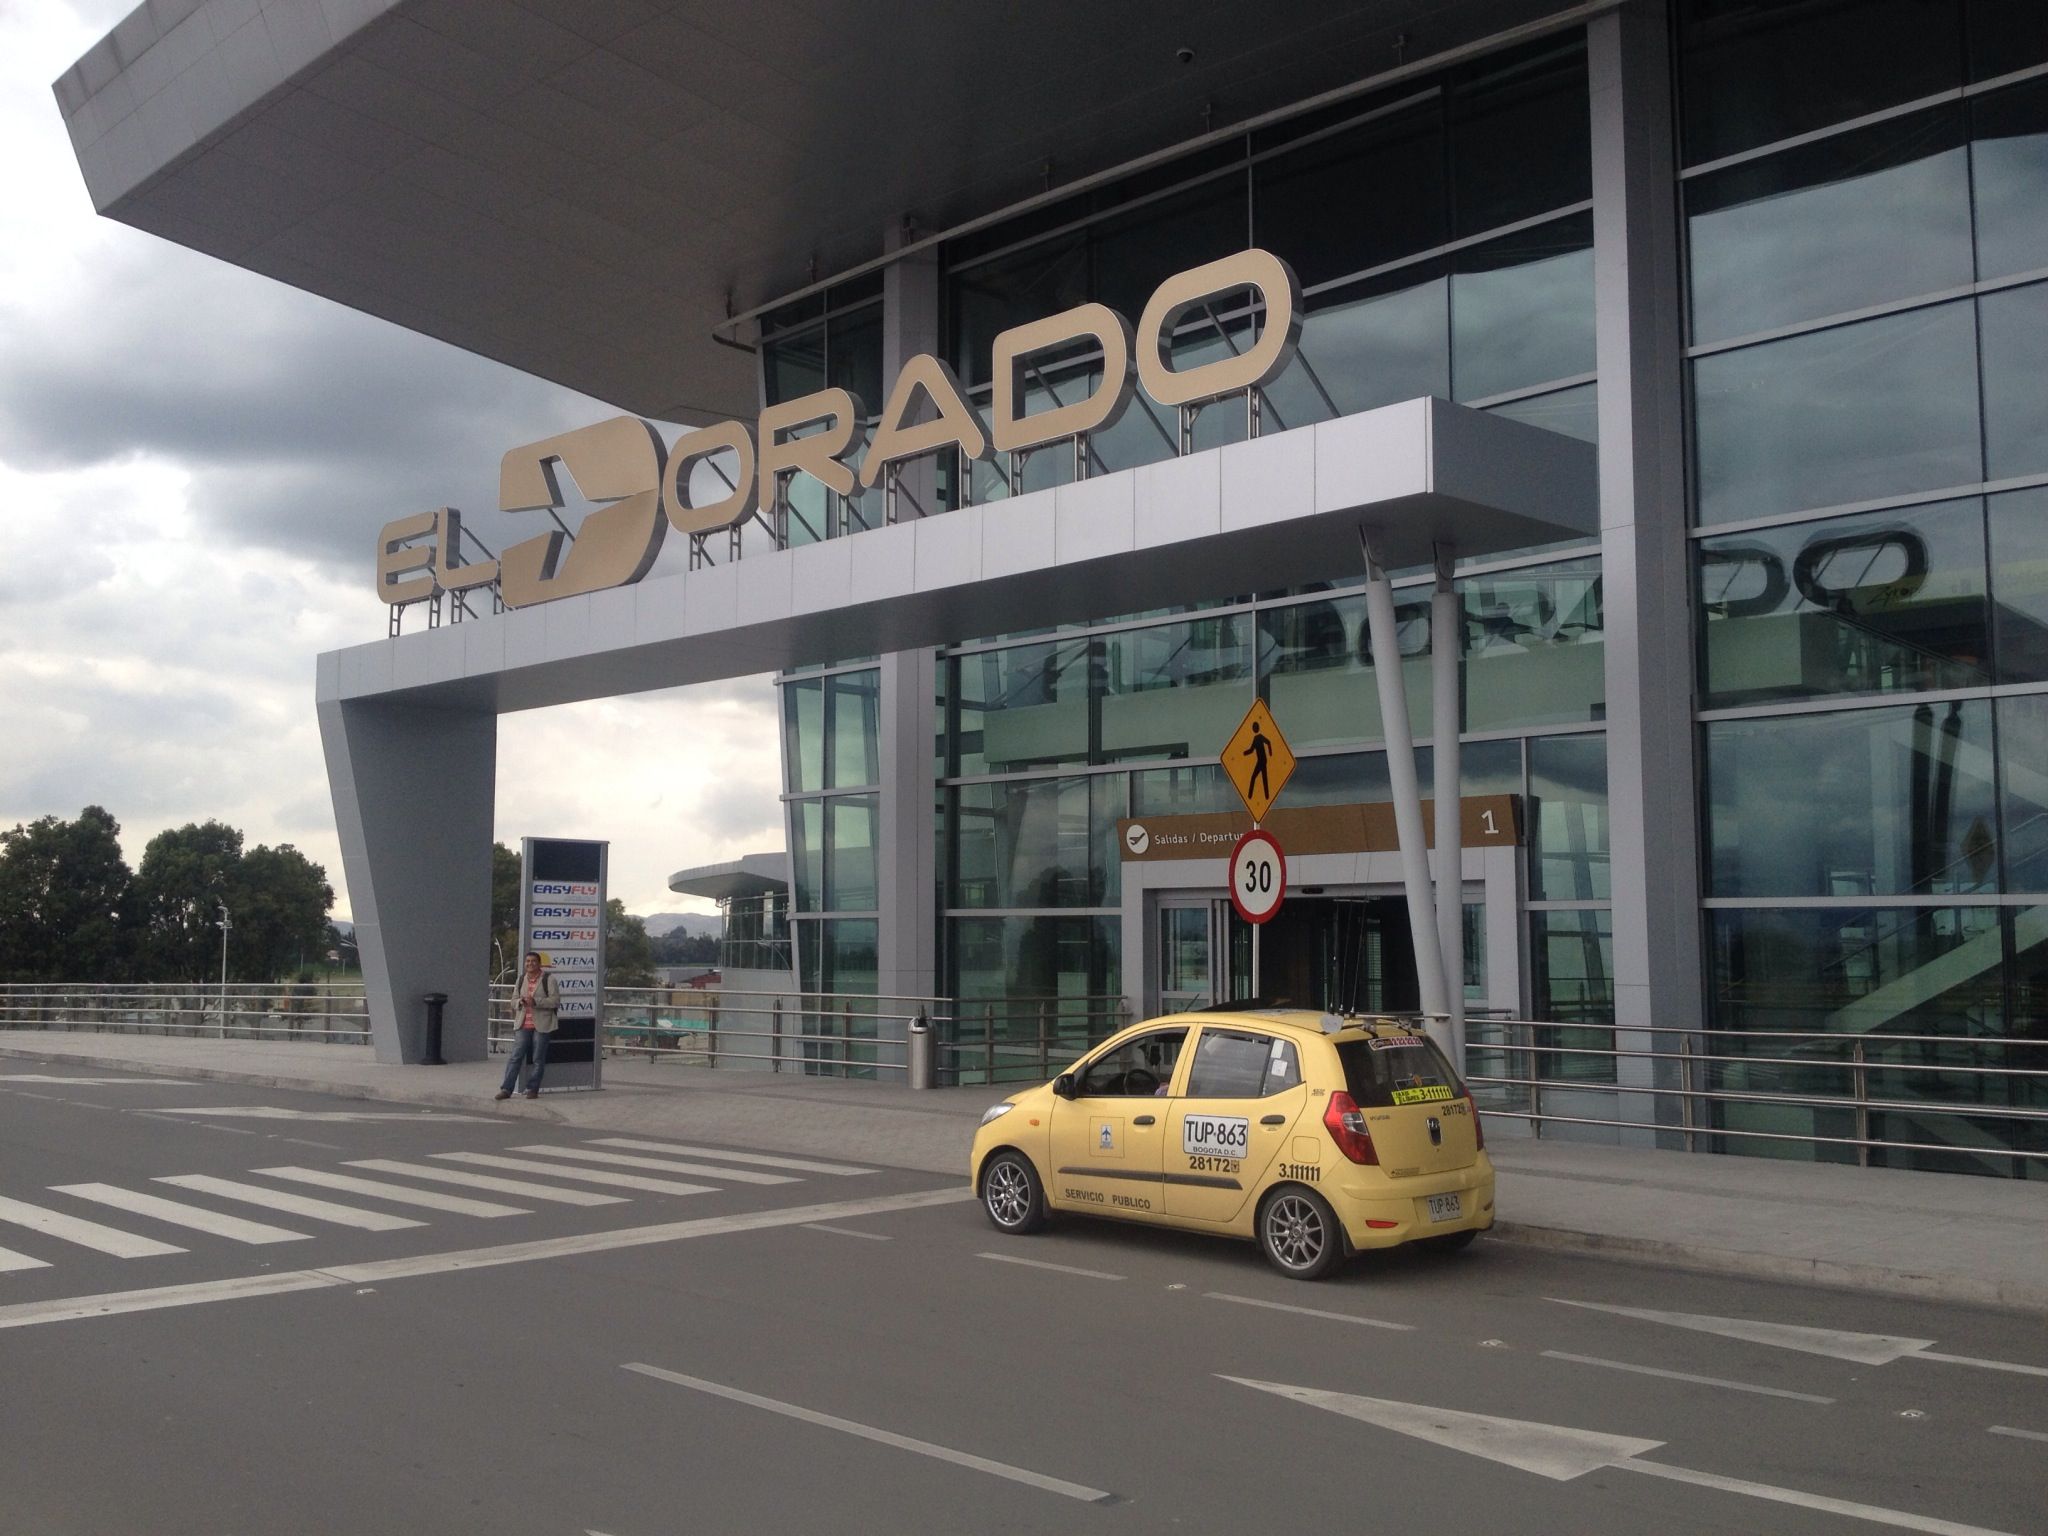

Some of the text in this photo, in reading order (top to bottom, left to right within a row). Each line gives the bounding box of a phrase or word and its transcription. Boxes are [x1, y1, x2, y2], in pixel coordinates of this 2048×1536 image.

[377, 248, 1303, 608] EL DORADO
[1481, 810, 1499, 834] 1
[1154, 834, 1188, 845] Salidas
[1200, 832, 1245, 845] Departur
[1245, 860, 1272, 893] 30
[534, 884, 597, 895] EASYFLY
[533, 907, 597, 918] EASYFLY
[533, 930, 596, 940] EASYFLY
[552, 956, 595, 966] SATENA
[558, 979, 594, 989] ATENA
[559, 1002, 593, 1011] ATENA
[1193, 1146, 1222, 1154] BOGOTA
[1189, 1155, 1231, 1173] 28172
[1065, 1188, 1151, 1210] SERVICIO PUBLICO
